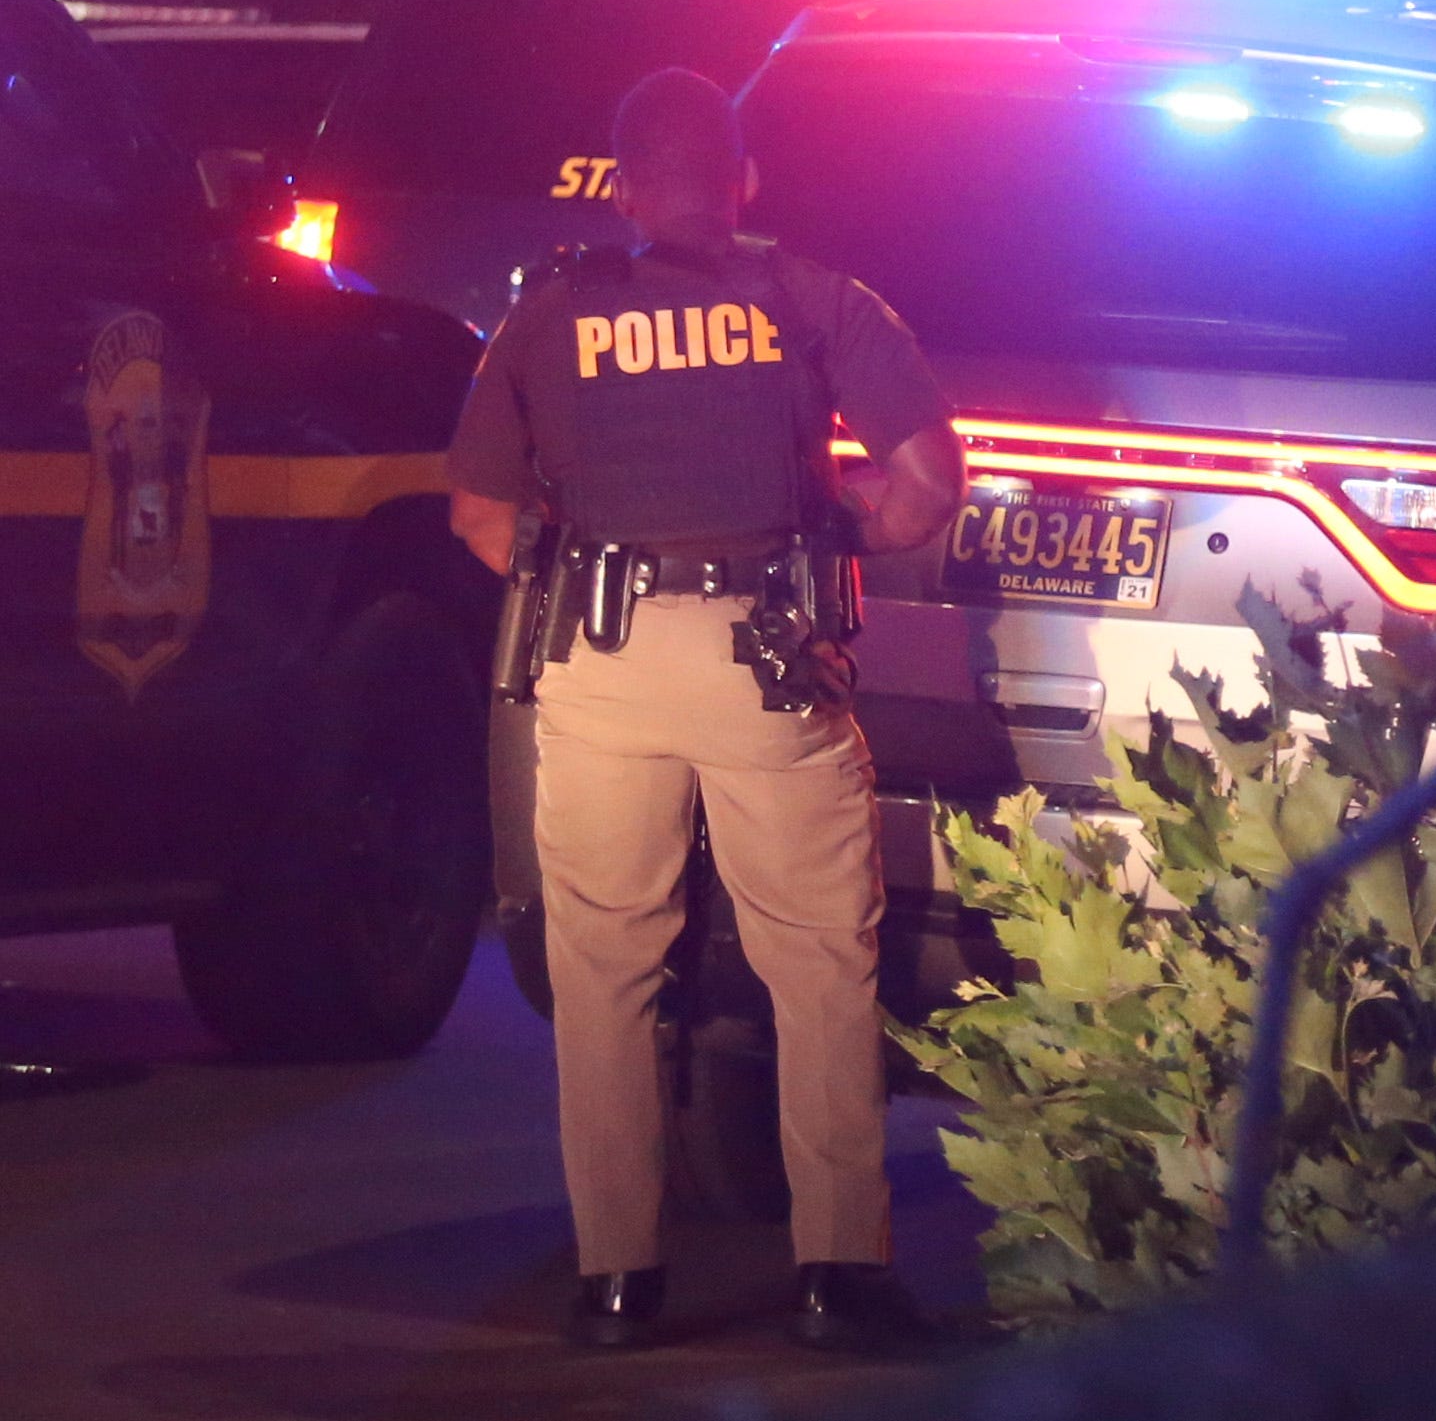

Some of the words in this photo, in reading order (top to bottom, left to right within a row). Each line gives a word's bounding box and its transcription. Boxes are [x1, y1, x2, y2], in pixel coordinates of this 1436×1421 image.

[550, 155, 618, 201] ST
[575, 302, 783, 378] POLICE
[1007, 491, 1030, 505] THE
[1037, 495, 1070, 508] FIRST
[1077, 497, 1116, 512] STATE
[952, 505, 1158, 576] C493445
[998, 573, 1095, 595] DELAWARE
[1127, 584, 1147, 598] 21
